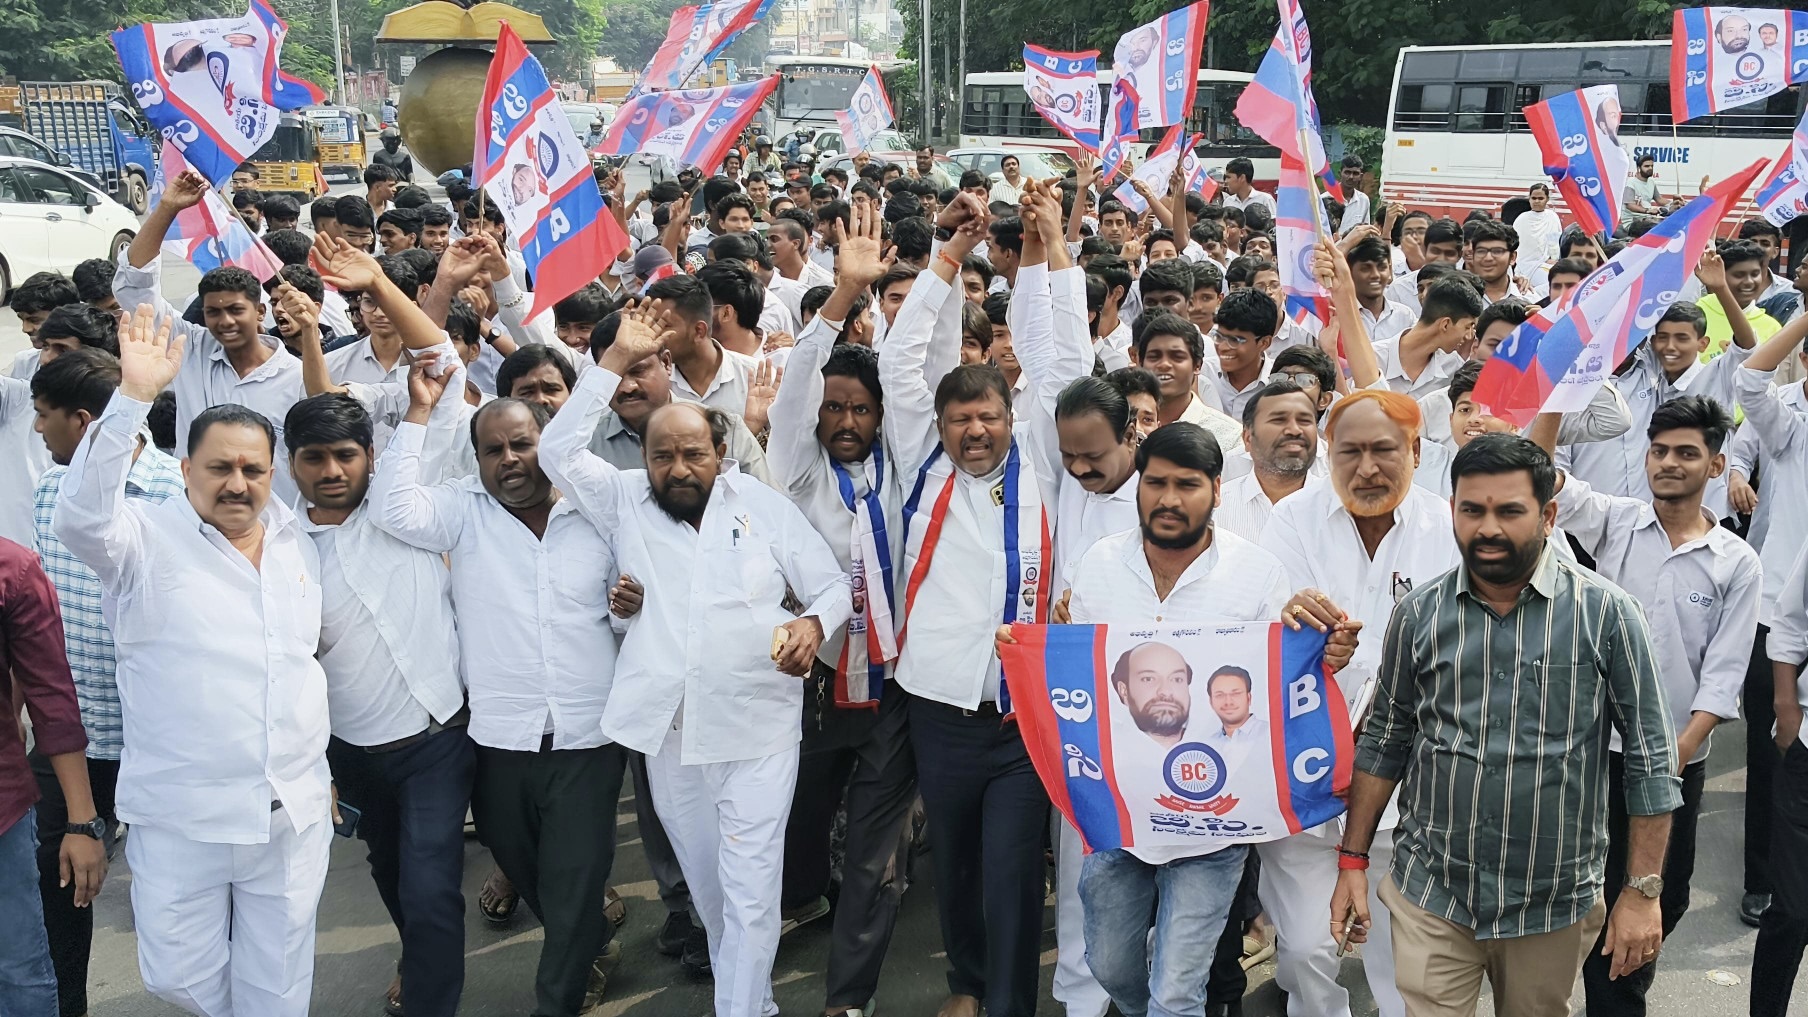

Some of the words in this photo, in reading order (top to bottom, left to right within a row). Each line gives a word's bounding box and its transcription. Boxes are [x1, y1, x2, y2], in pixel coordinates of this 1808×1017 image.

[1633, 147, 1690, 164] SERVICE
[1051, 687, 1093, 723] బి
[1288, 673, 1321, 720] B
[1063, 743, 1103, 781] సి
[1180, 762, 1208, 782] BC
[1292, 747, 1330, 783] C
